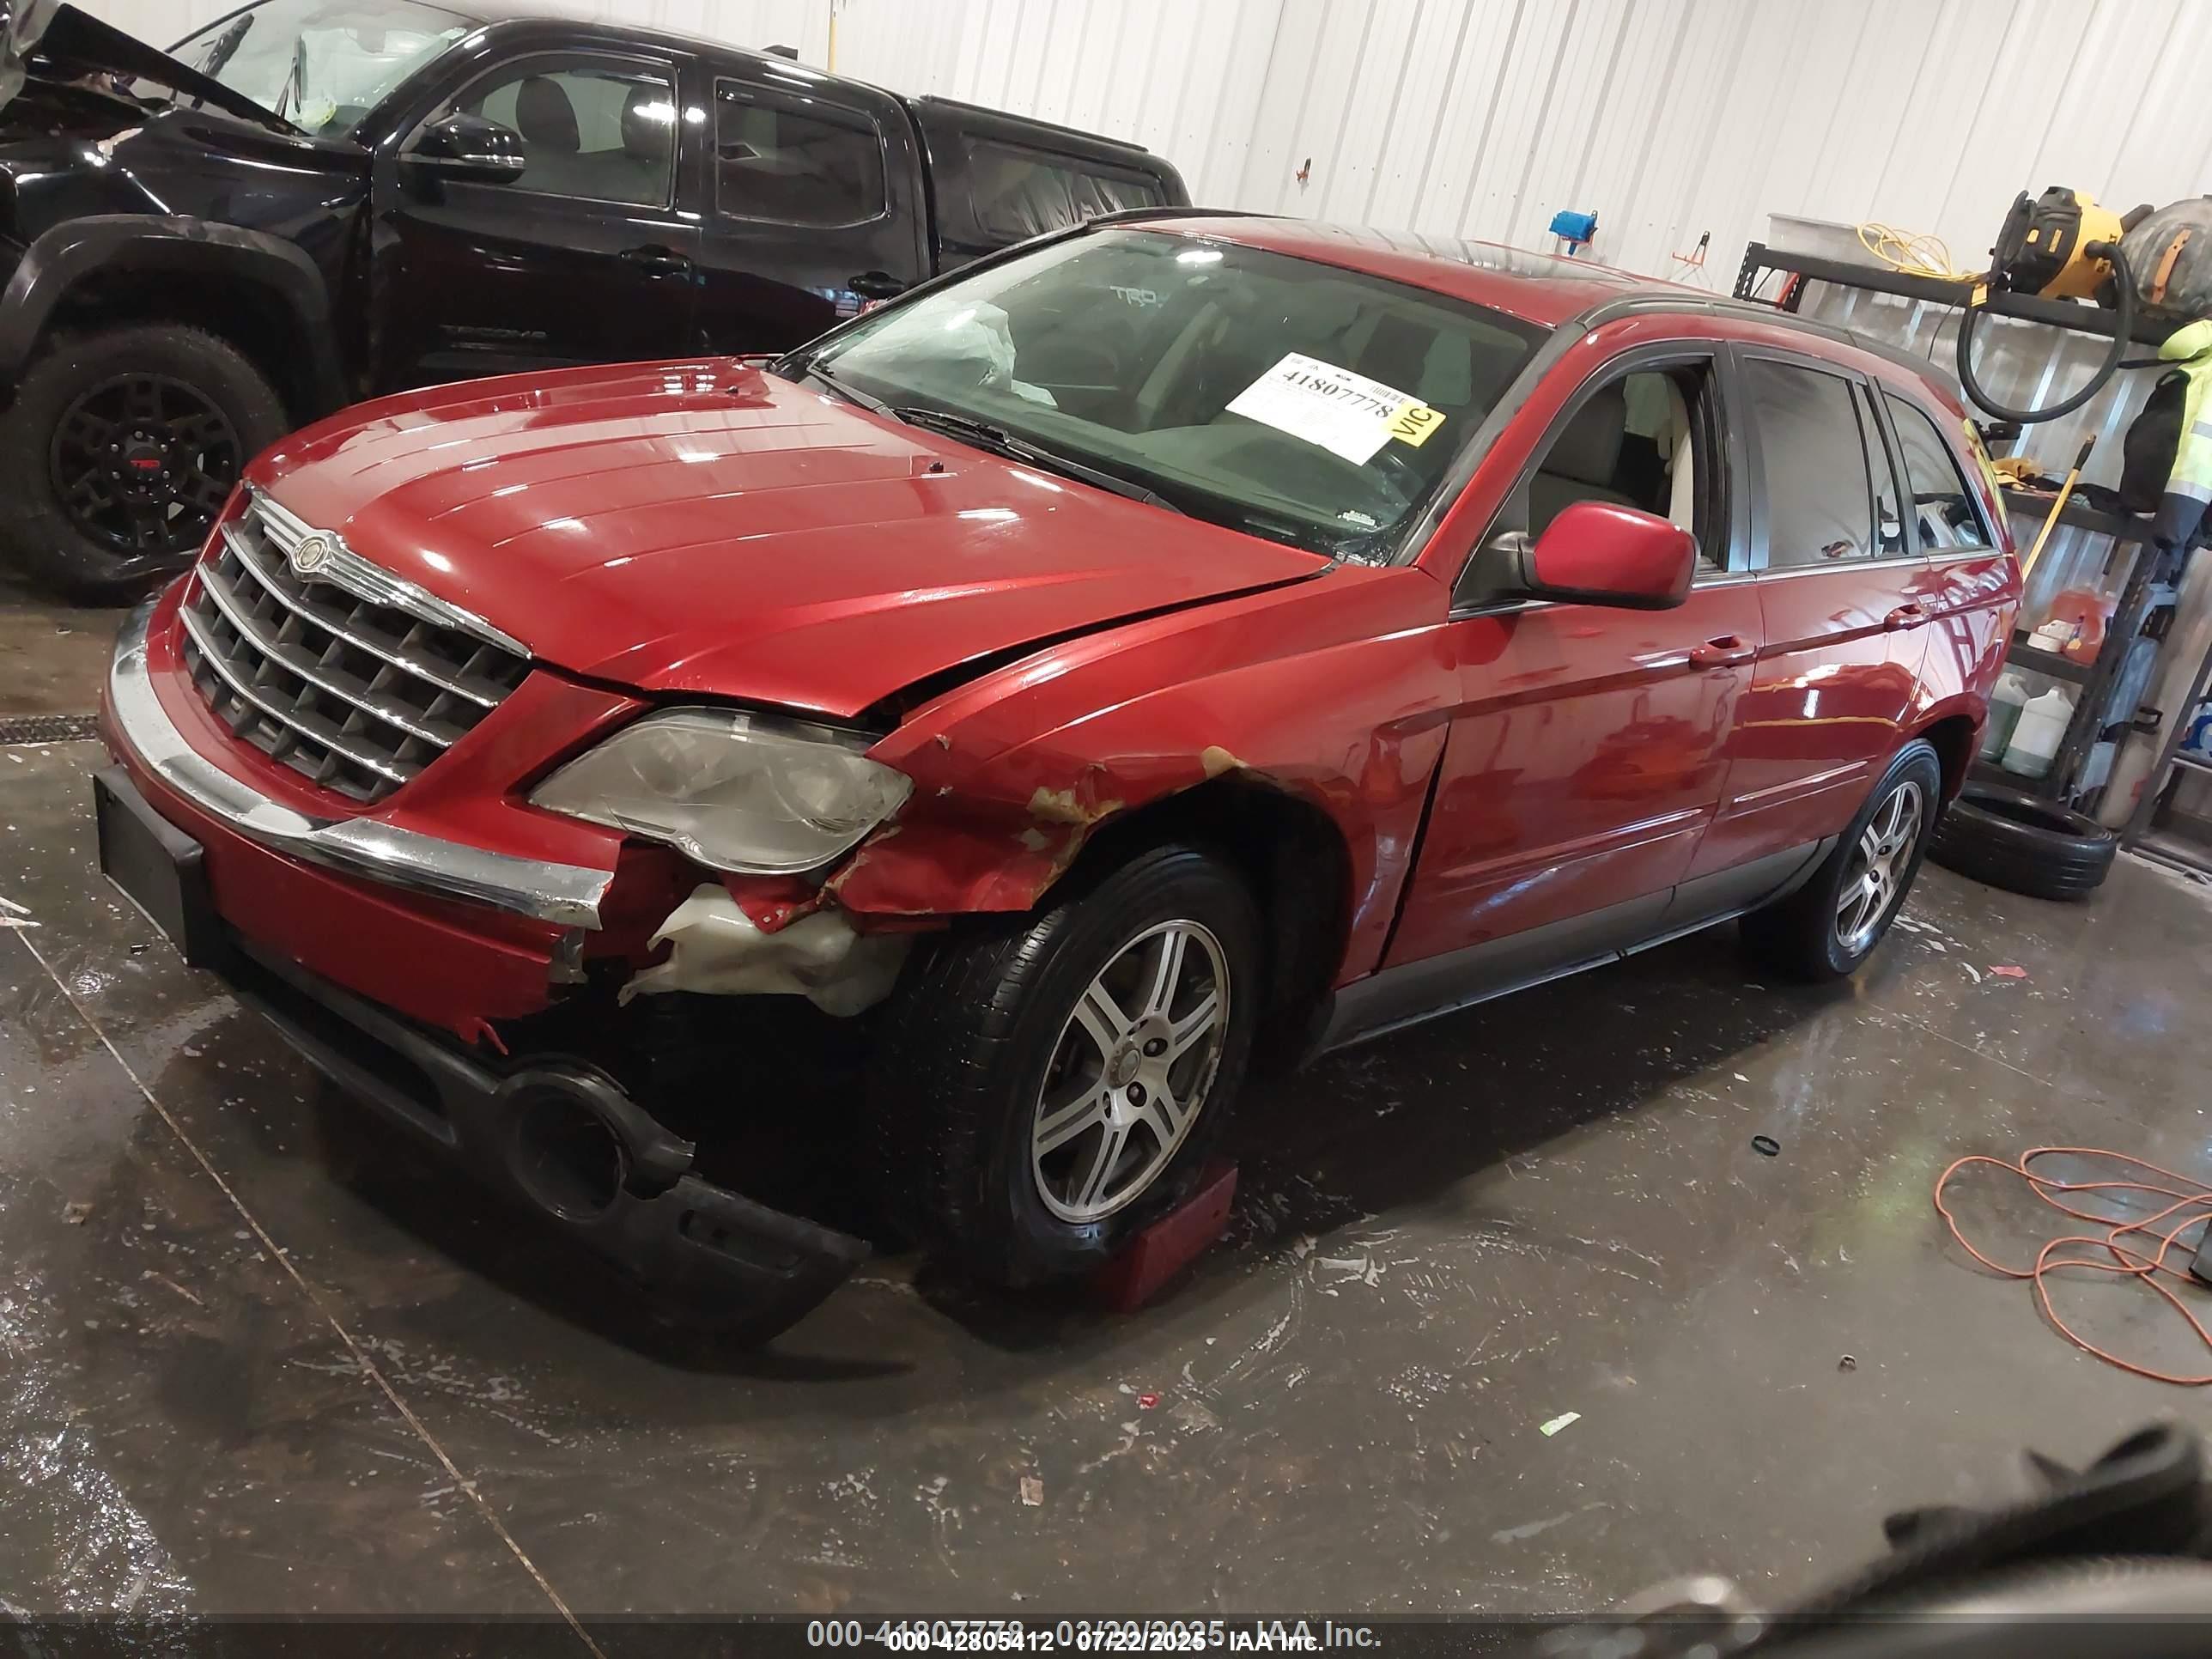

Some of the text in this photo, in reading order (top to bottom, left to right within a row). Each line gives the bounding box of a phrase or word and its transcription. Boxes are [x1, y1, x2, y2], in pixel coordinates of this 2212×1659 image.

[1109, 285, 1157, 307] TRD
[1282, 371, 1395, 418] 41807778
[1392, 407, 1433, 436] VIC
